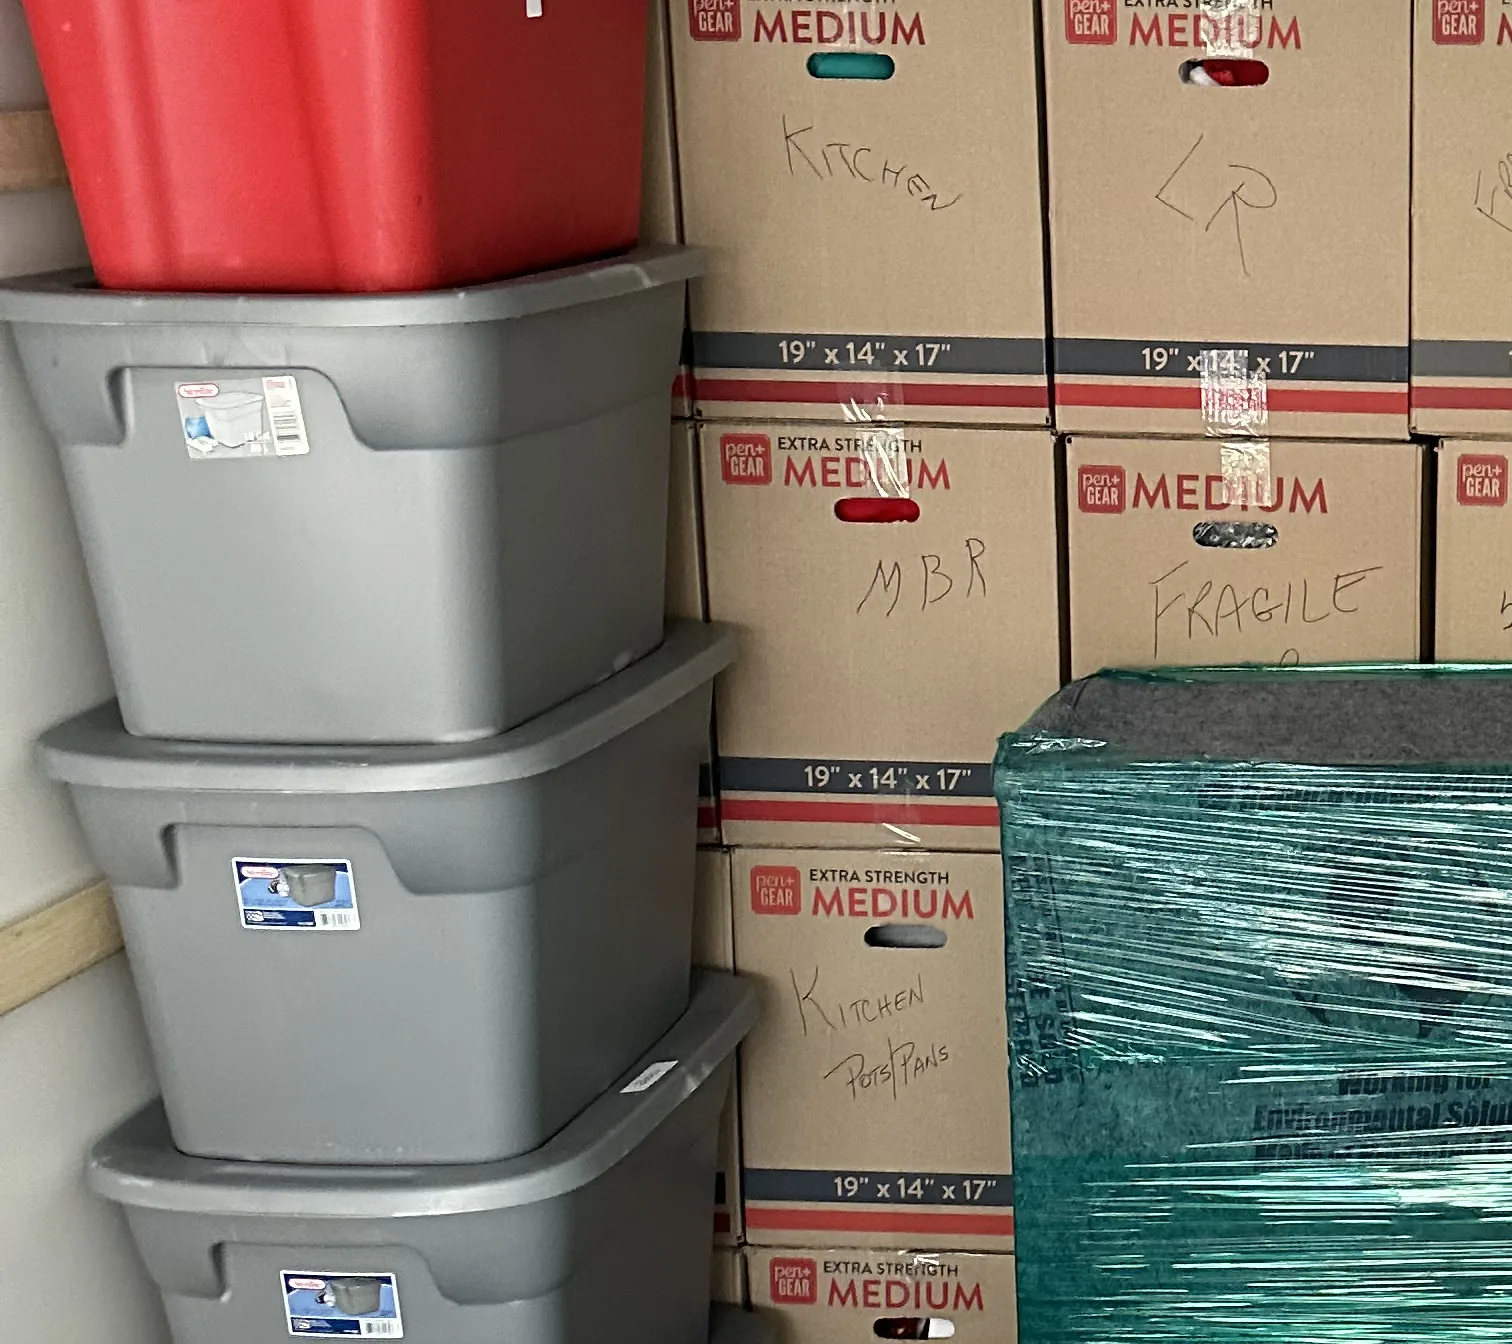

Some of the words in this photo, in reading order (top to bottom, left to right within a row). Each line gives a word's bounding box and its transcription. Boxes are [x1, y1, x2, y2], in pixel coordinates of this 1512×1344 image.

[1070, 0, 1111, 20] pen+
[699, 12, 733, 33] GEAR
[753, 9, 926, 45] MEDIUM
[1075, 14, 1109, 36] GEAR
[1130, 12, 1301, 49] MEDIUM
[1441, 14, 1476, 36] GEAR
[780, 114, 962, 211] KITCHEN
[778, 338, 816, 365] 19"
[824, 348, 839, 365] x
[846, 341, 886, 366] 14"
[893, 350, 908, 367] x
[912, 343, 951, 368] 17"
[1142, 347, 1180, 371] 19"
[1187, 356, 1201, 371] x
[1256, 357, 1271, 373] x
[1278, 350, 1315, 374] 17"
[725, 443, 766, 462] pen+
[778, 437, 830, 452] EXTRA
[730, 459, 764, 477] GEAR
[1463, 463, 1502, 483] pen+
[1082, 473, 1120, 492] pen+
[1132, 472, 1328, 514] MEDIUM
[1466, 478, 1500, 498] GEAR
[1087, 487, 1119, 506] GEAR
[857, 536, 987, 617] MBR
[1149, 560, 1383, 659] FRAGILE
[804, 765, 841, 789] 19"
[849, 773, 863, 790] x
[870, 767, 908, 790] 14"
[916, 775, 930, 791] x
[936, 769, 972, 792] 17"
[809, 869, 861, 883] EXTRA
[865, 870, 949, 884] STRENGTH
[760, 890, 793, 907] GEAR
[811, 887, 974, 919] MEDIUM
[790, 966, 925, 1036] KITCHEN
[834, 1176, 869, 1196] 19"
[876, 1183, 890, 1198] x
[898, 1178, 935, 1200] 14"
[942, 1185, 956, 1200] x
[963, 1180, 997, 1200] 17"
[823, 1260, 873, 1275] EXTRA
[877, 1262, 958, 1277] STRENGTH
[778, 1279, 809, 1296] GEAR
[828, 1279, 984, 1311] MEDIUM
